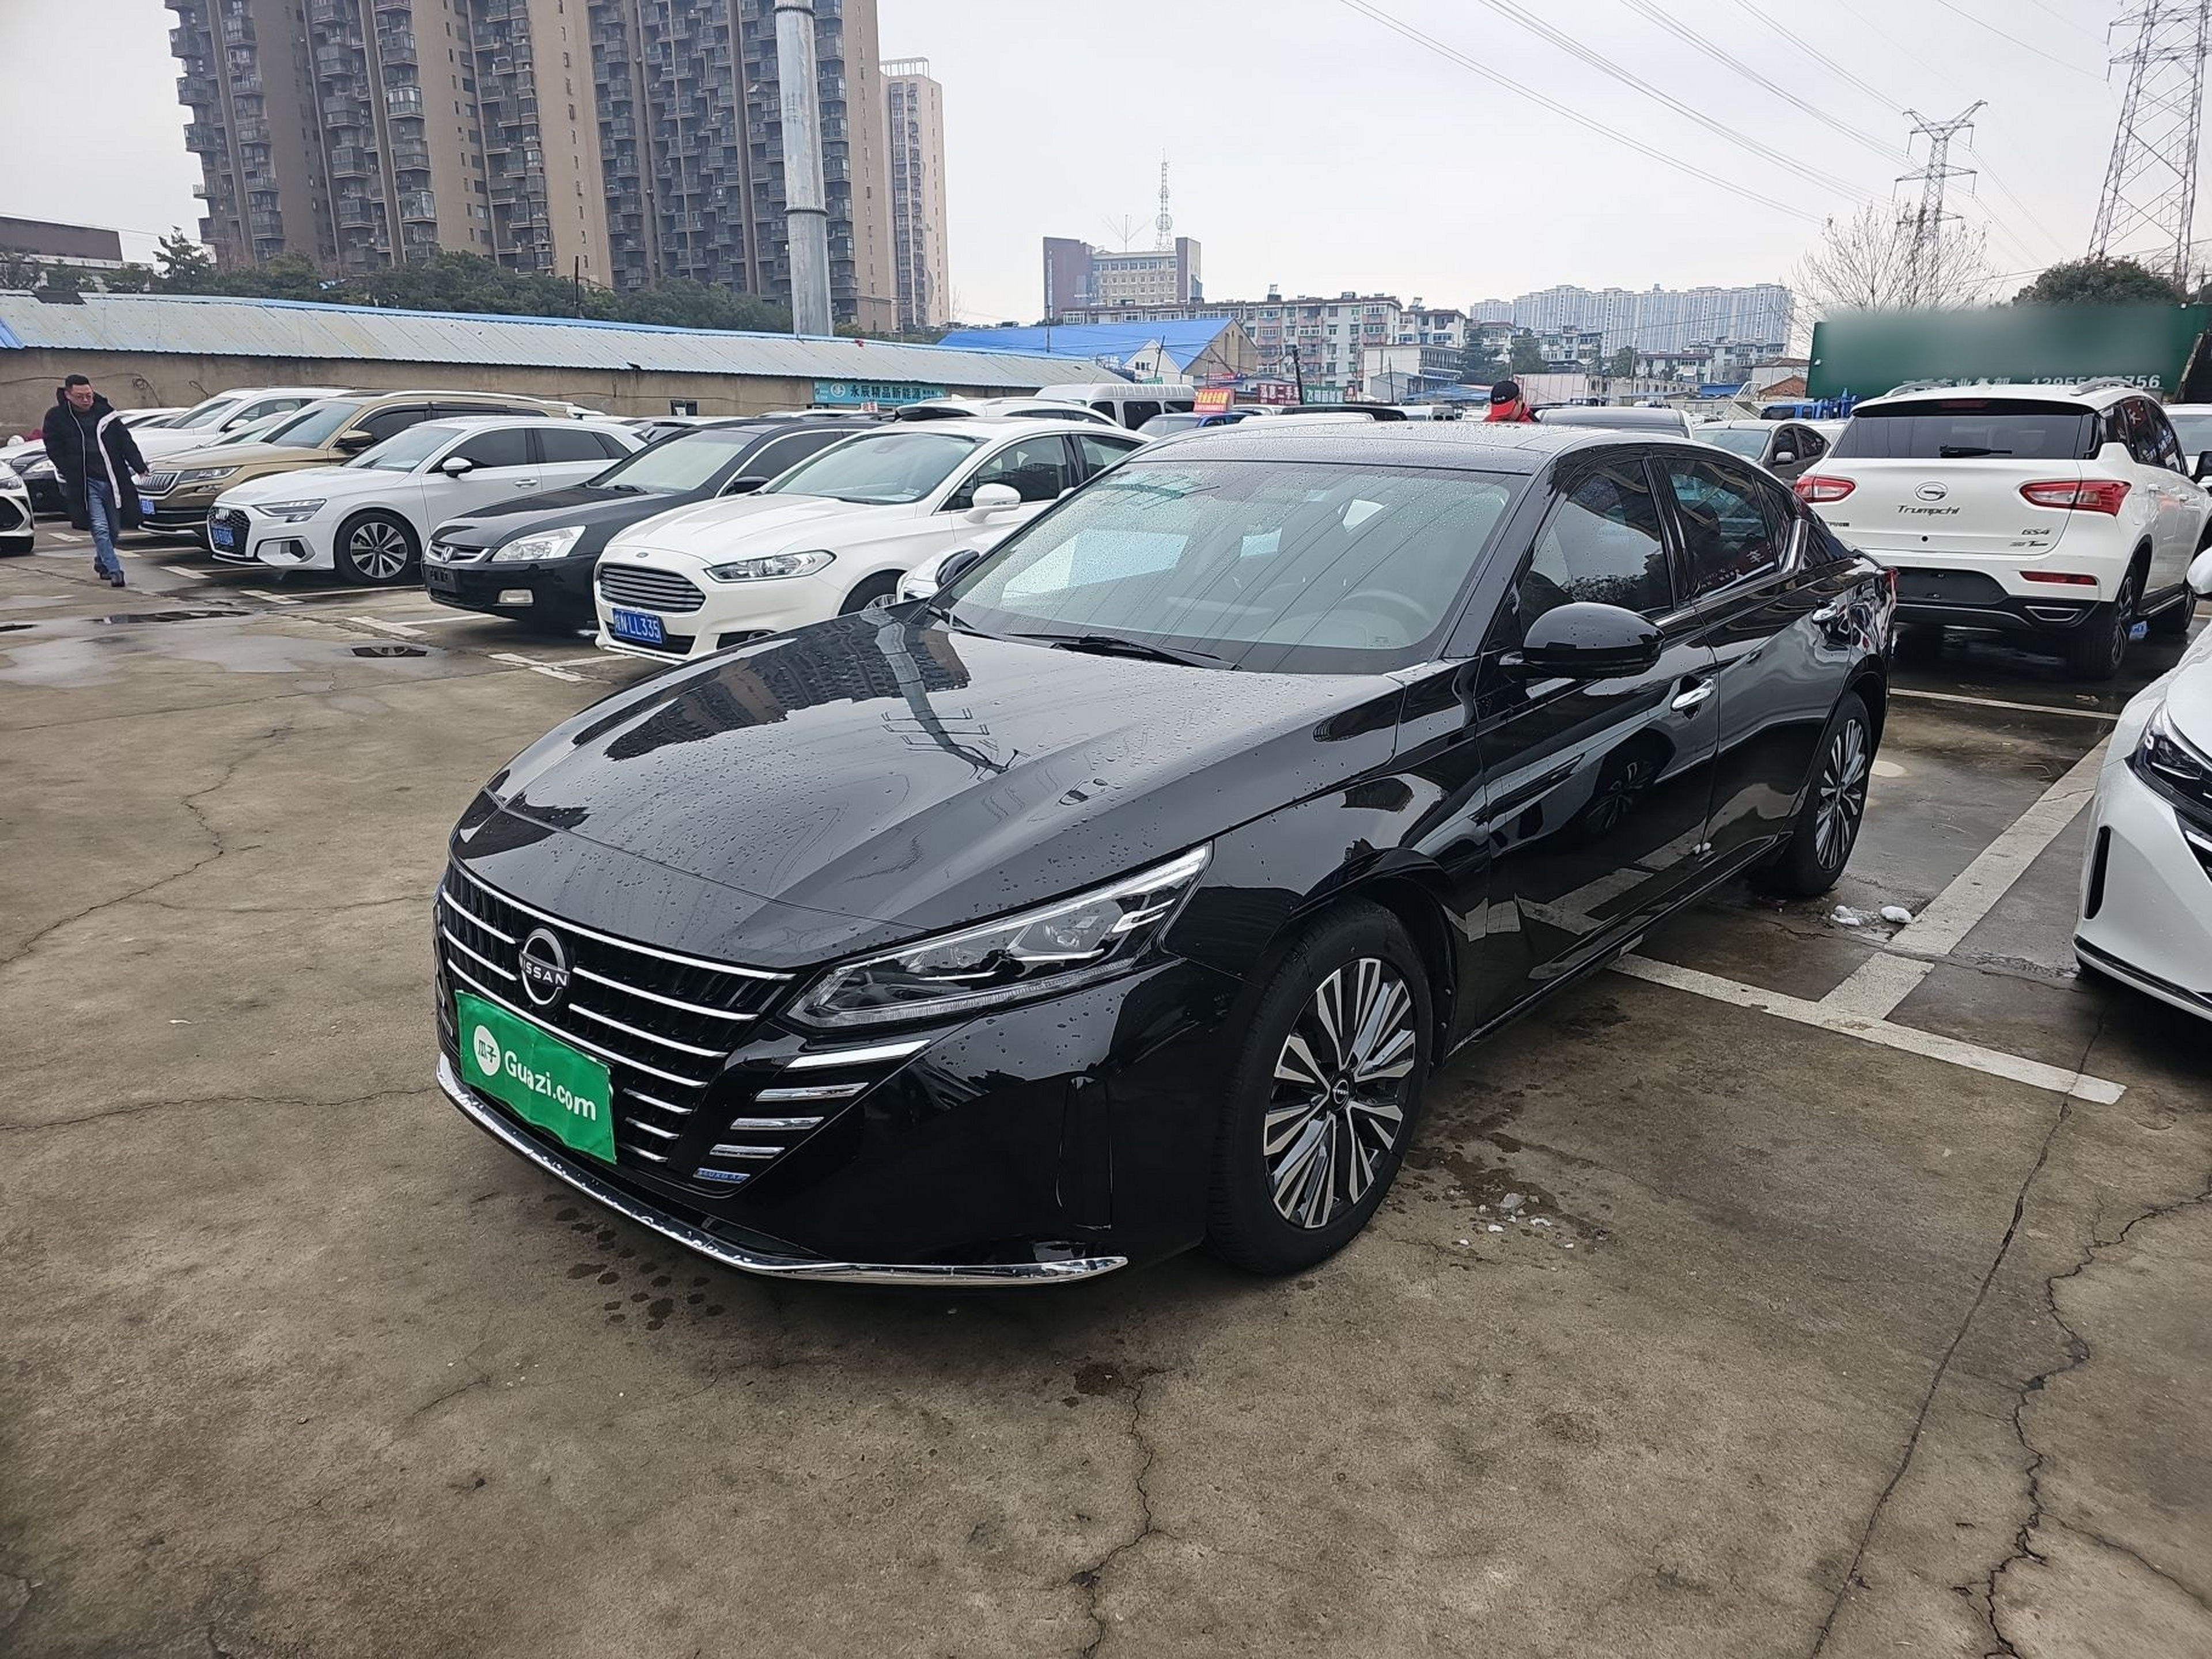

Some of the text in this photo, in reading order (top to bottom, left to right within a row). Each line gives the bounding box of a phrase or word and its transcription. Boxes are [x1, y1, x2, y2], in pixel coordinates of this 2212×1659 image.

[1897, 505, 1960, 516] Trumpchi
[478, 1039, 597, 1122] 瓜子 Guazi.com
